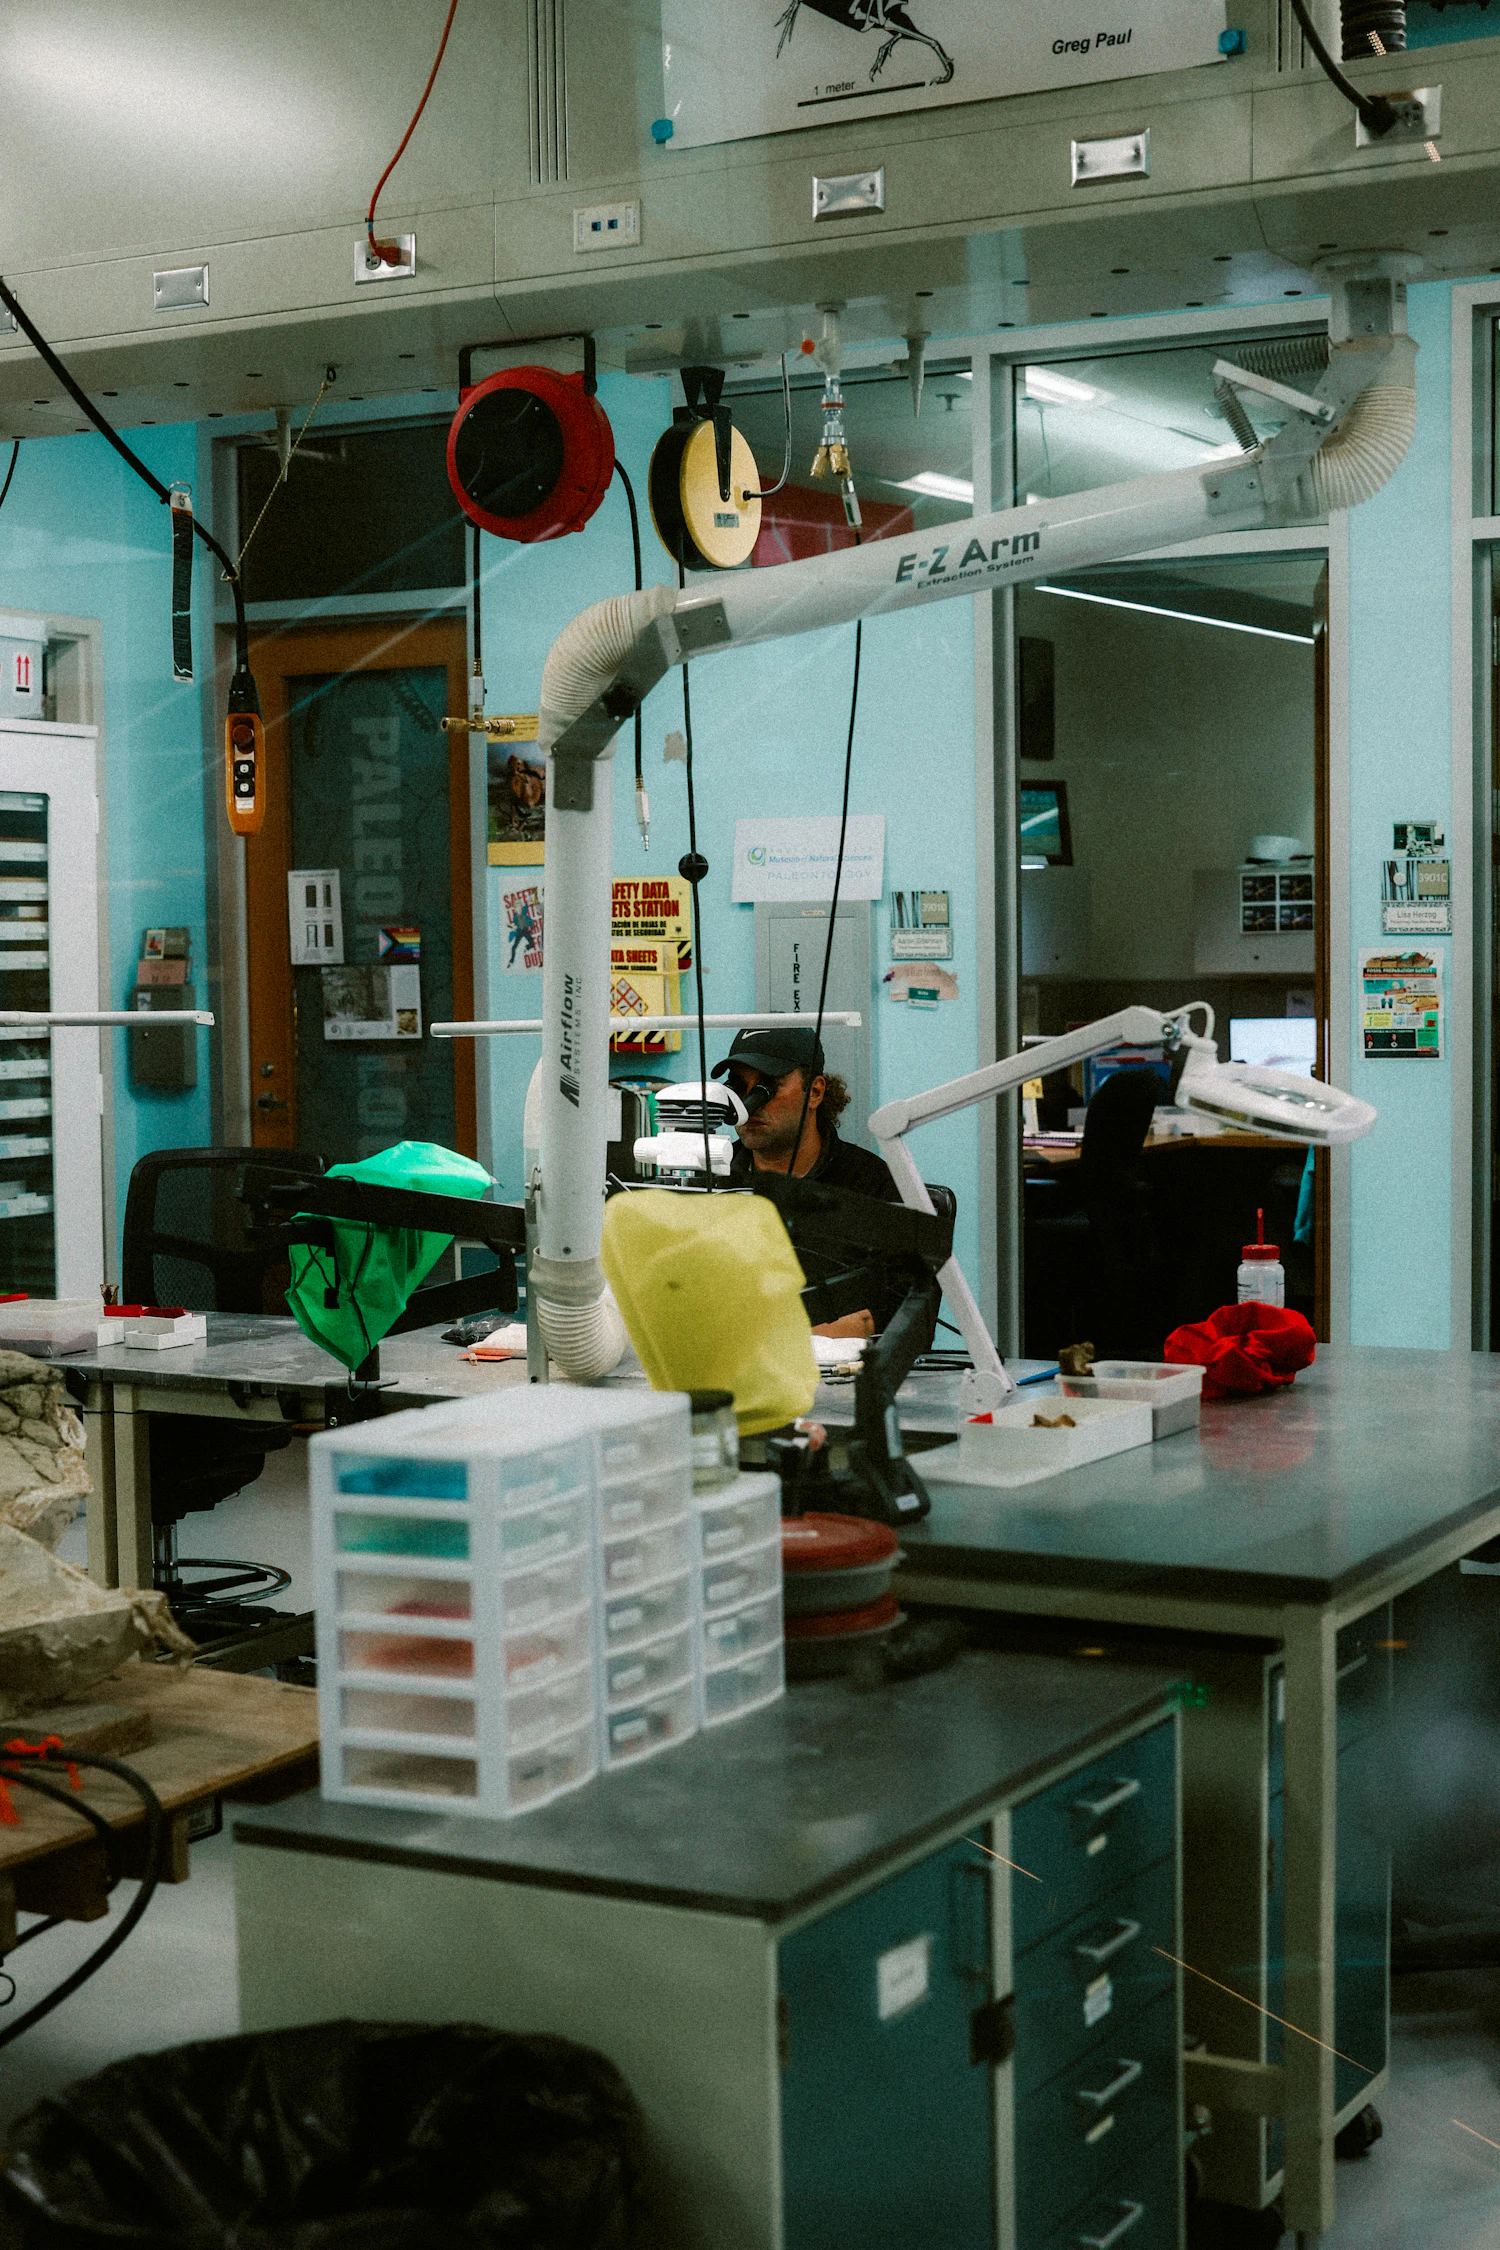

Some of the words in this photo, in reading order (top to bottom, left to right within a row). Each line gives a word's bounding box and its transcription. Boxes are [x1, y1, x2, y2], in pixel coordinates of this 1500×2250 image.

[1051, 38, 1090, 54] Greg
[1096, 29, 1133, 48] Paul
[813, 85, 820, 96] 1
[825, 80, 856, 94] meter
[895, 545, 950, 584] E-Z
[959, 531, 1040, 568] Arm
[917, 564, 982, 589] Extraction
[986, 555, 1034, 572] System
[769, 855, 800, 863] Museum
[838, 854, 873, 862] ciences
[767, 870, 871, 881] PALEONTOOGY
[1418, 873, 1448, 883] 3901C
[642, 882, 670, 899] DATA
[633, 900, 679, 917] STATION
[1413, 911, 1437, 919] Herzog
[626, 950, 658, 963] SHEETS
[560, 974, 574, 1072] Airflow
